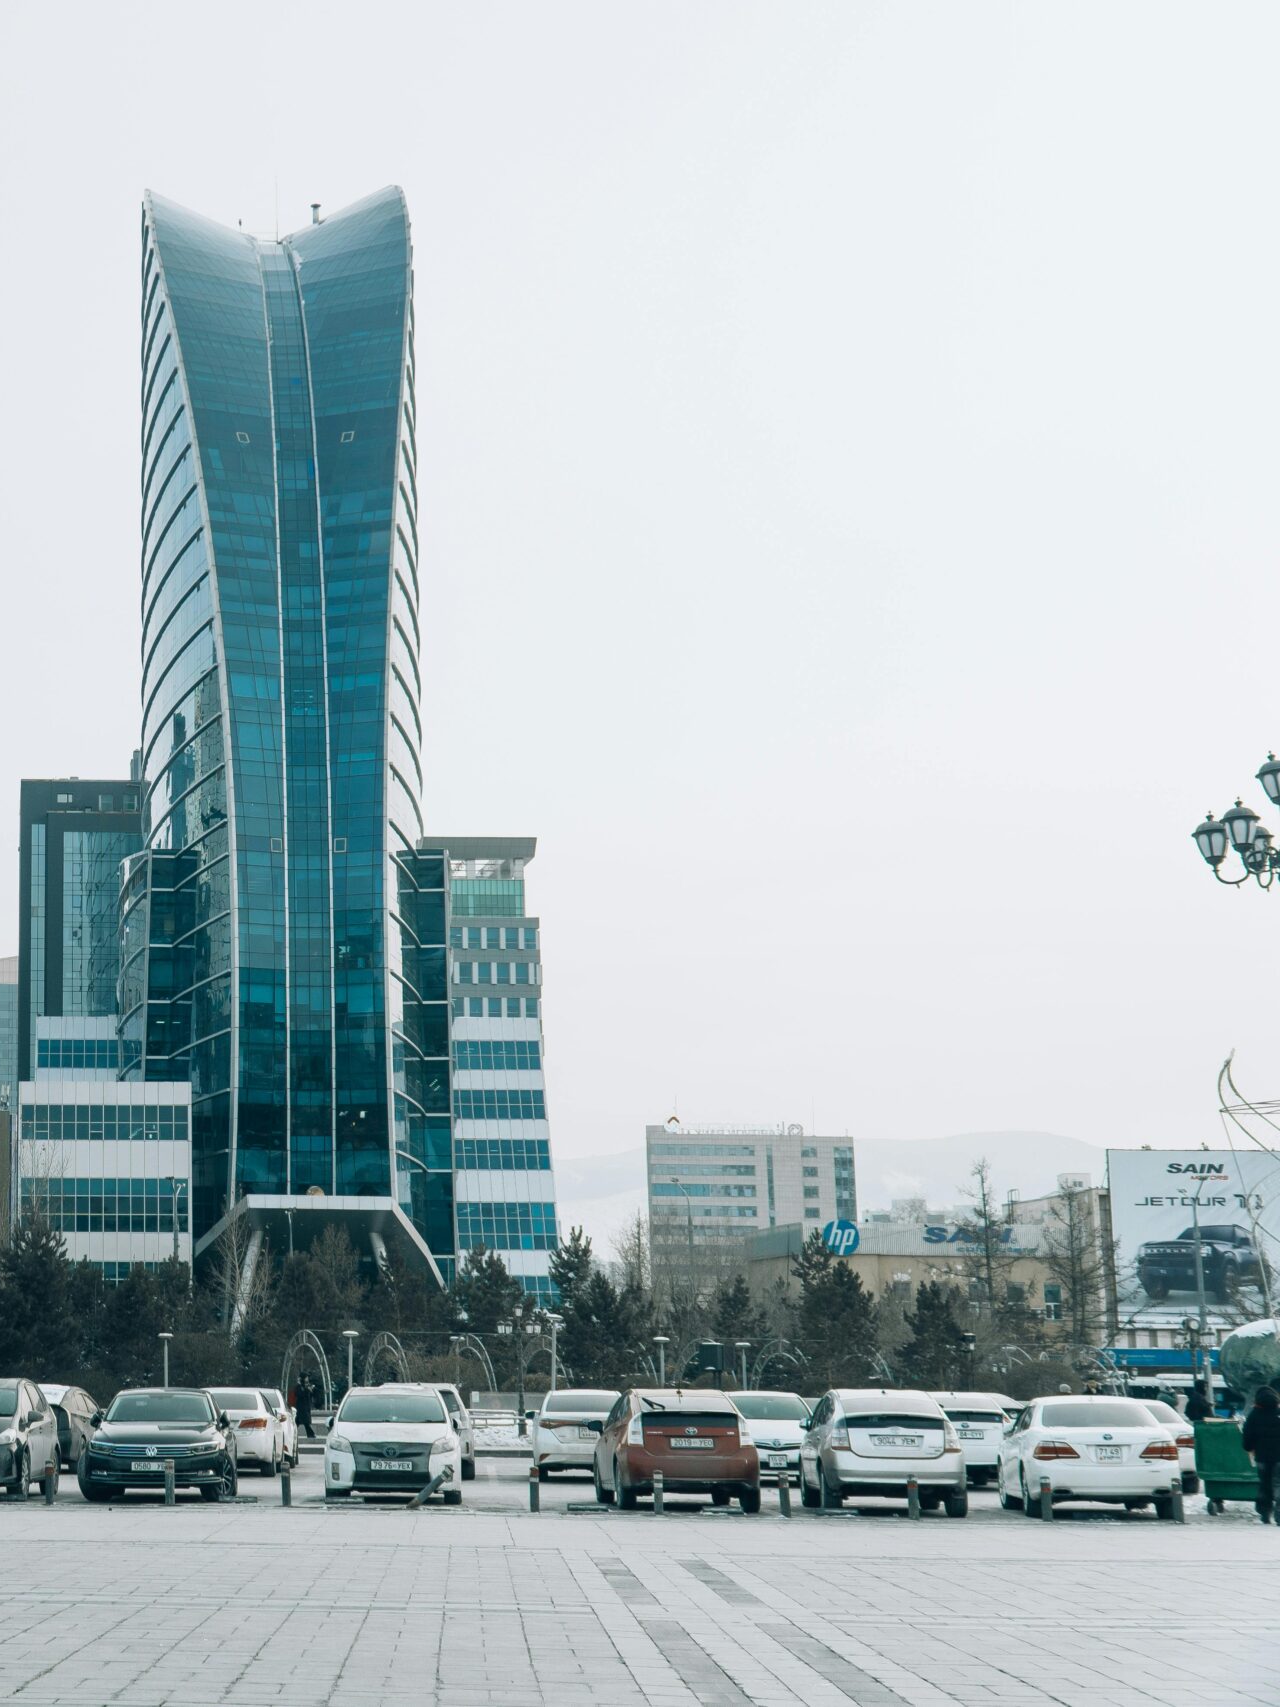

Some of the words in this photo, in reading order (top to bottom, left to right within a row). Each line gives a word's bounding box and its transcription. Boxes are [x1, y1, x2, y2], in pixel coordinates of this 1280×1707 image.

[1167, 1163, 1224, 1174] SAIN
[1134, 1197, 1226, 1206] JETOUR
[828, 1219, 856, 1256] hp
